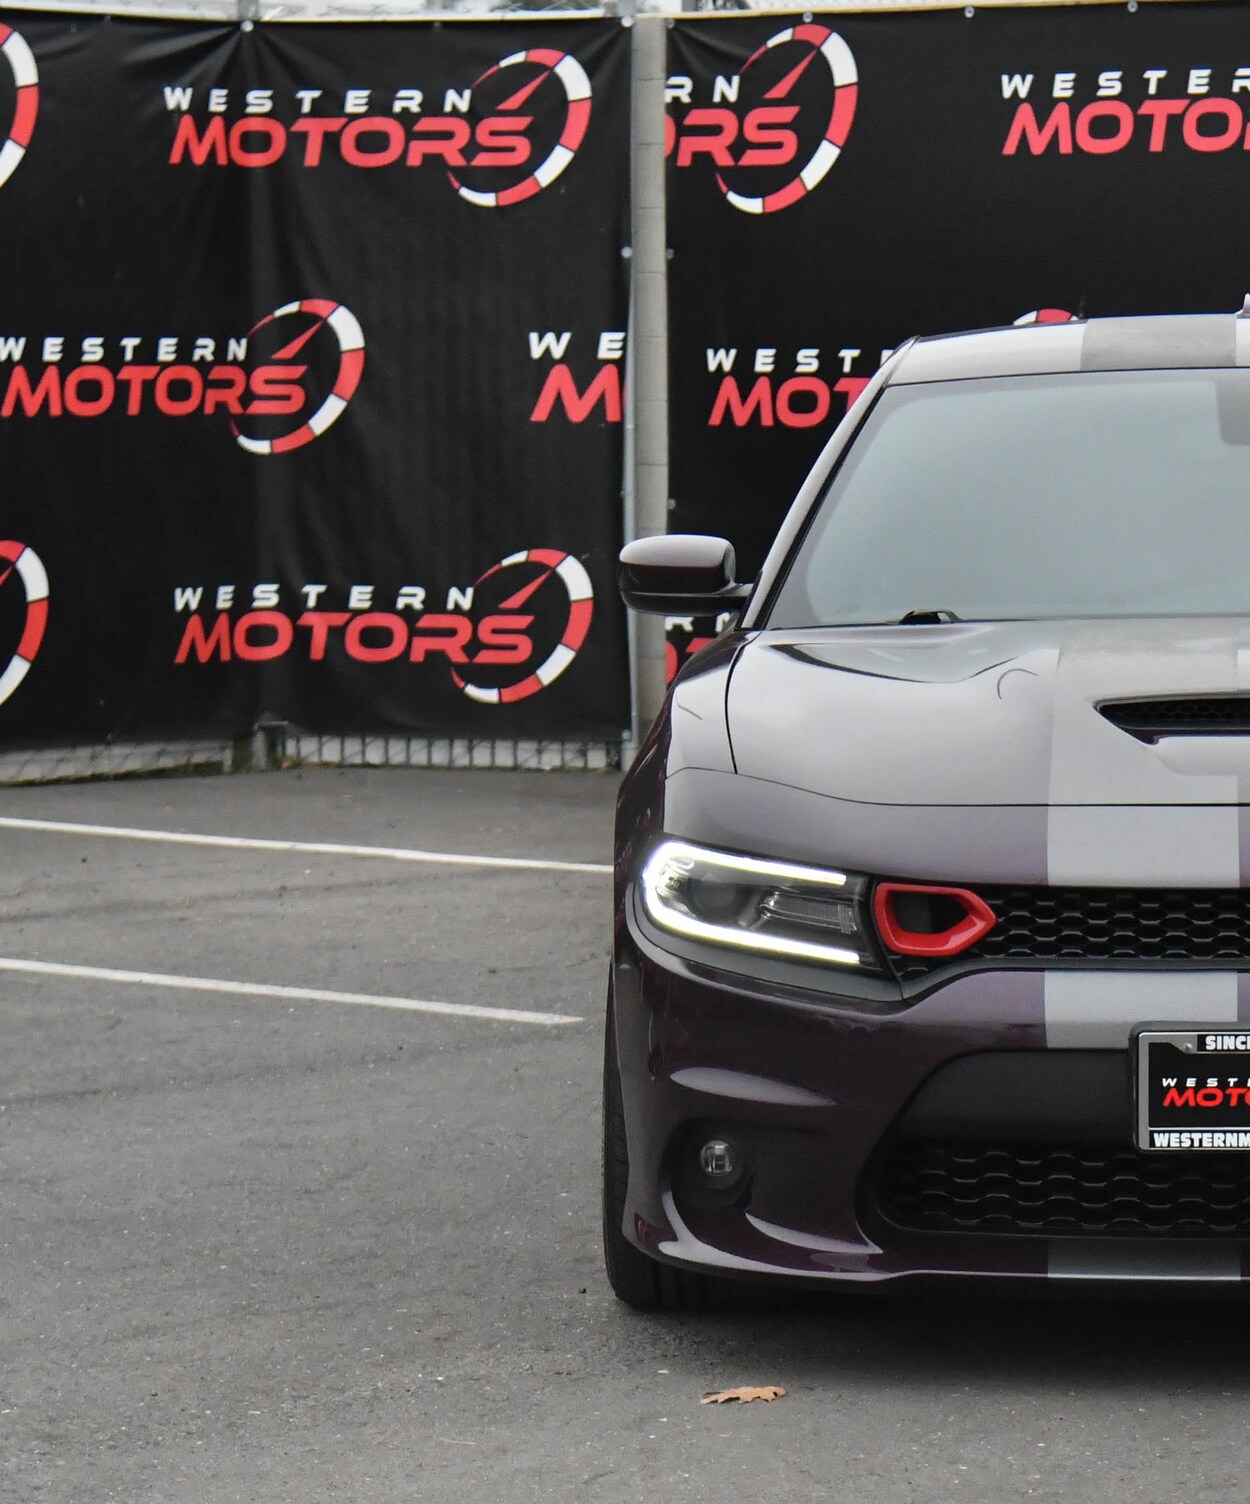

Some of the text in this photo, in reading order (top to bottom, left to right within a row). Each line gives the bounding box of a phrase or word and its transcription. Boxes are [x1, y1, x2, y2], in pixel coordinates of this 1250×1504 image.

[163, 86, 472, 113] WESTERN
[169, 115, 533, 168] MOTORS
[665, 106, 800, 167] RS
[0, 336, 247, 362] WESTERN
[1, 365, 307, 417] MOTORS
[174, 583, 474, 611] WESTERN
[174, 610, 534, 664] MOTORS
